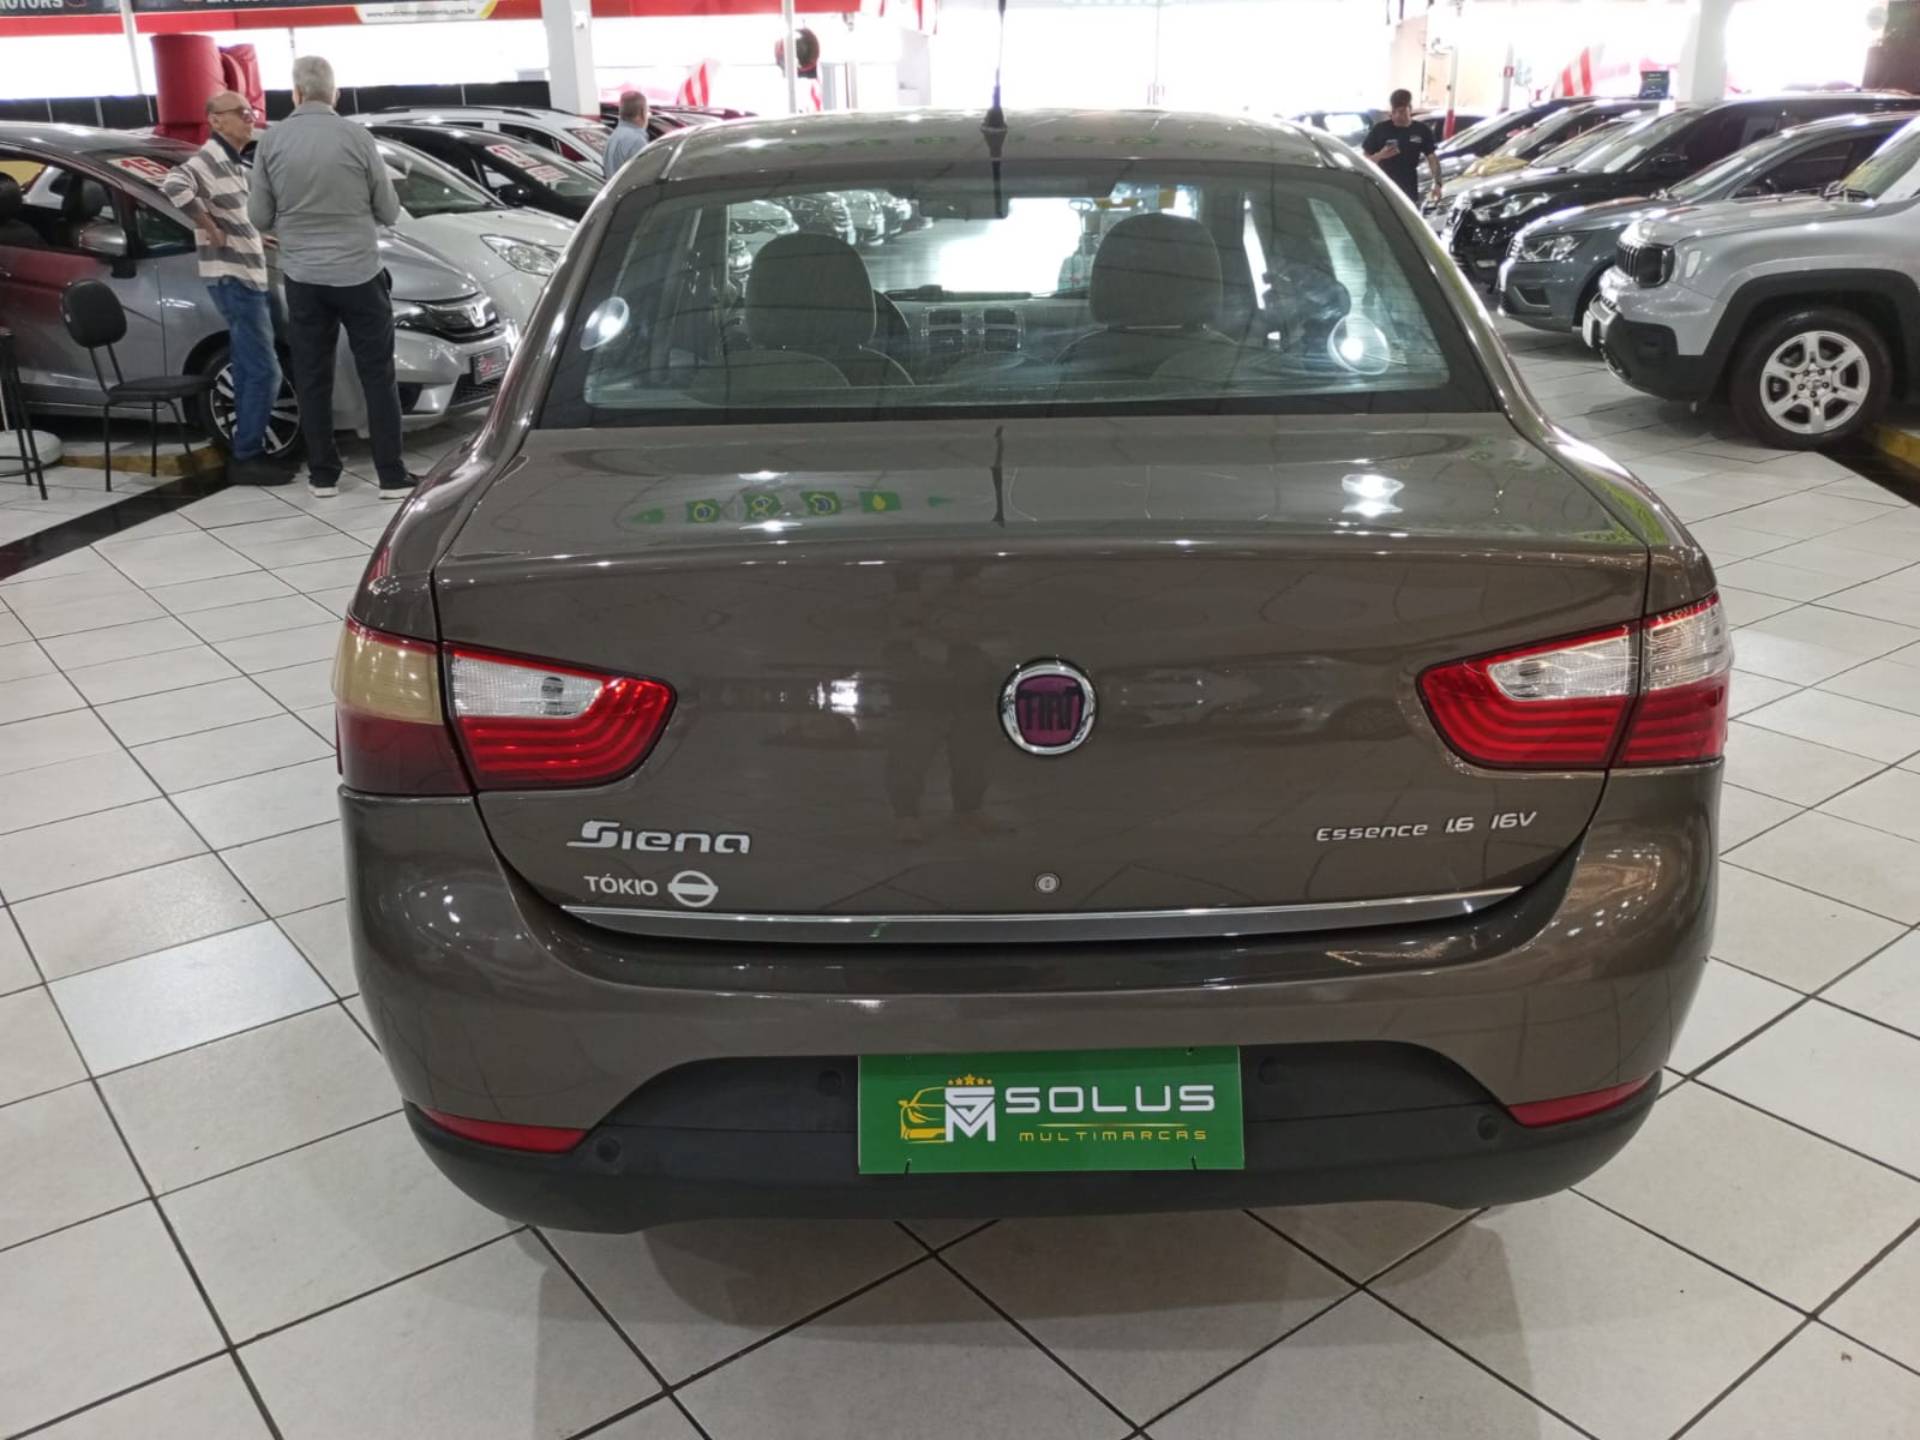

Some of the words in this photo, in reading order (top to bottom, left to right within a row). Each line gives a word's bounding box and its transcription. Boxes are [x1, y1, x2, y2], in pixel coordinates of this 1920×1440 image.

[566, 819, 751, 854] Siena
[1316, 823, 1429, 842] Essence
[1491, 811, 1538, 830] 16V
[583, 872, 659, 897] TÓKIO
[1005, 1084, 1216, 1114] SOLUS
[1018, 1129, 1207, 1143] MULTIMARCAS
